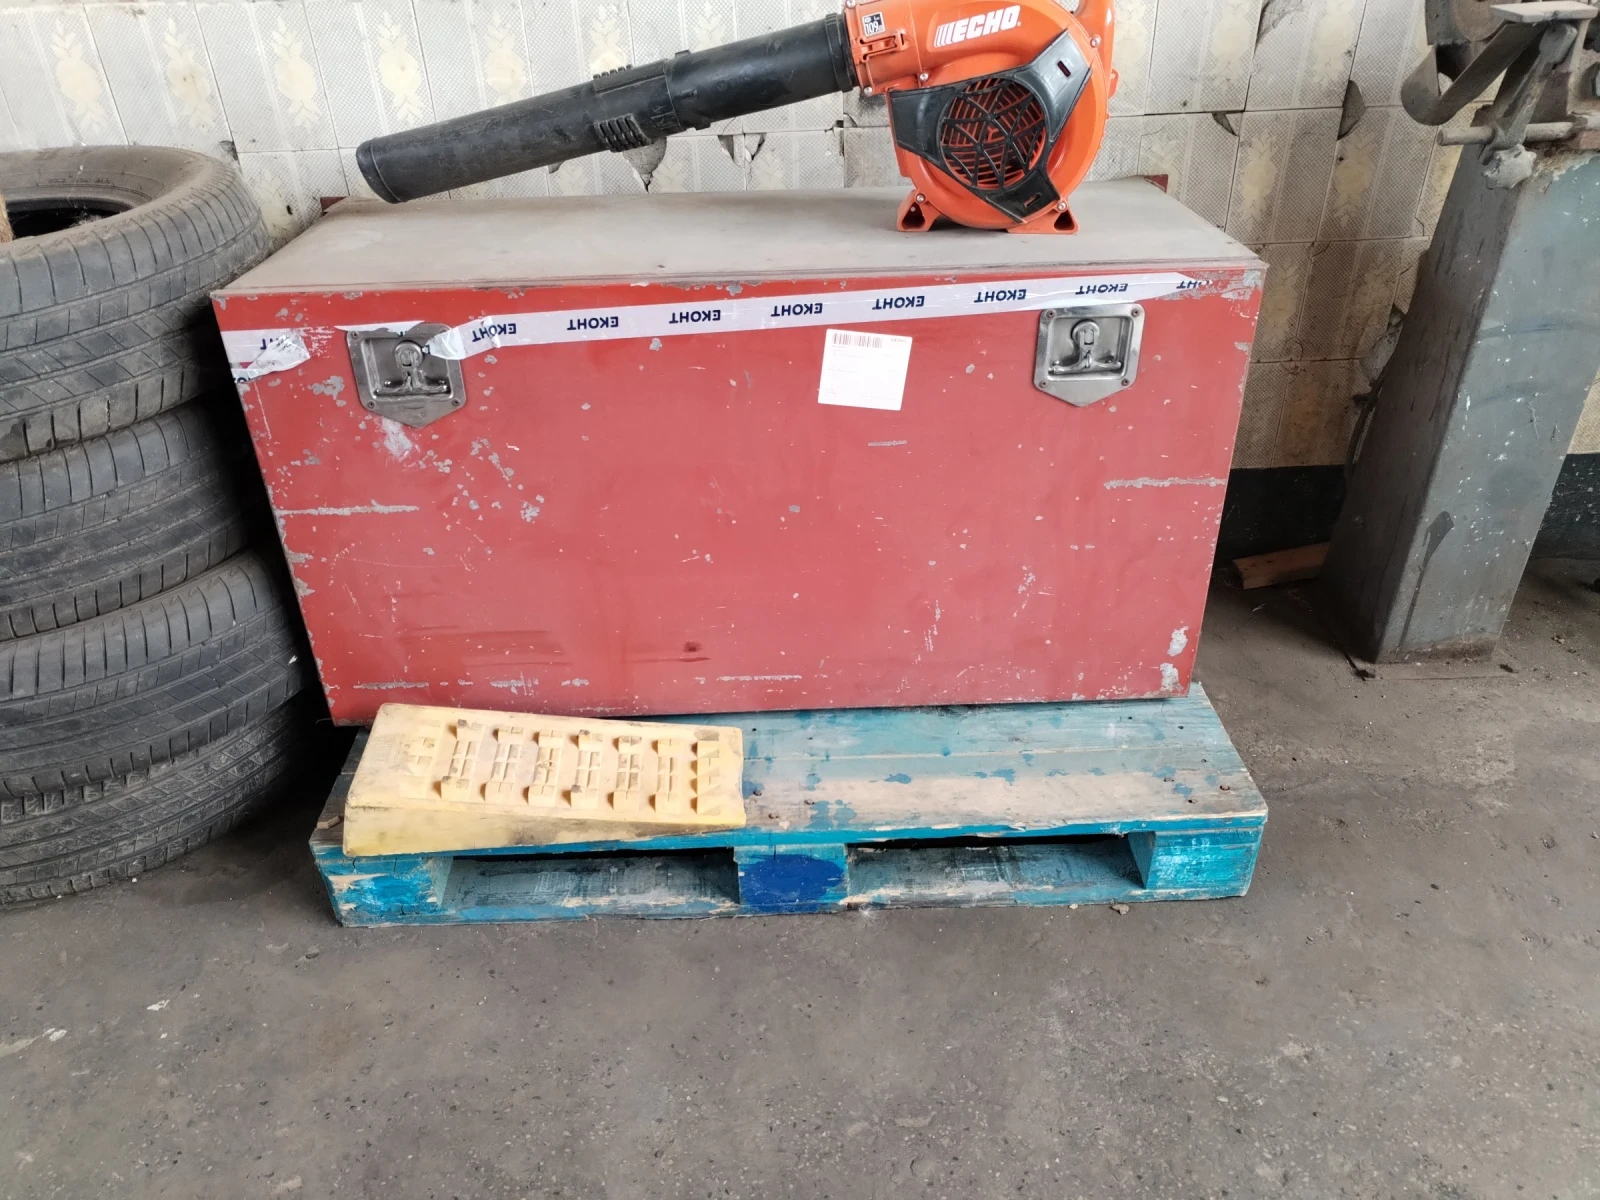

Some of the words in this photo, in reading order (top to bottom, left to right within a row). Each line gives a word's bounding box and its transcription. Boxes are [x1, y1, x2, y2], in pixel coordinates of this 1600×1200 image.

[951, 5, 1021, 43] ECHO
[871, 295, 925, 311] ЕКОНТ
[974, 288, 1027, 303] ЕКОНТ
[669, 309, 721, 324] ЕКОНТ
[771, 302, 823, 317] ЕКОНТ
[567, 316, 619, 331] ЕКОНТ
